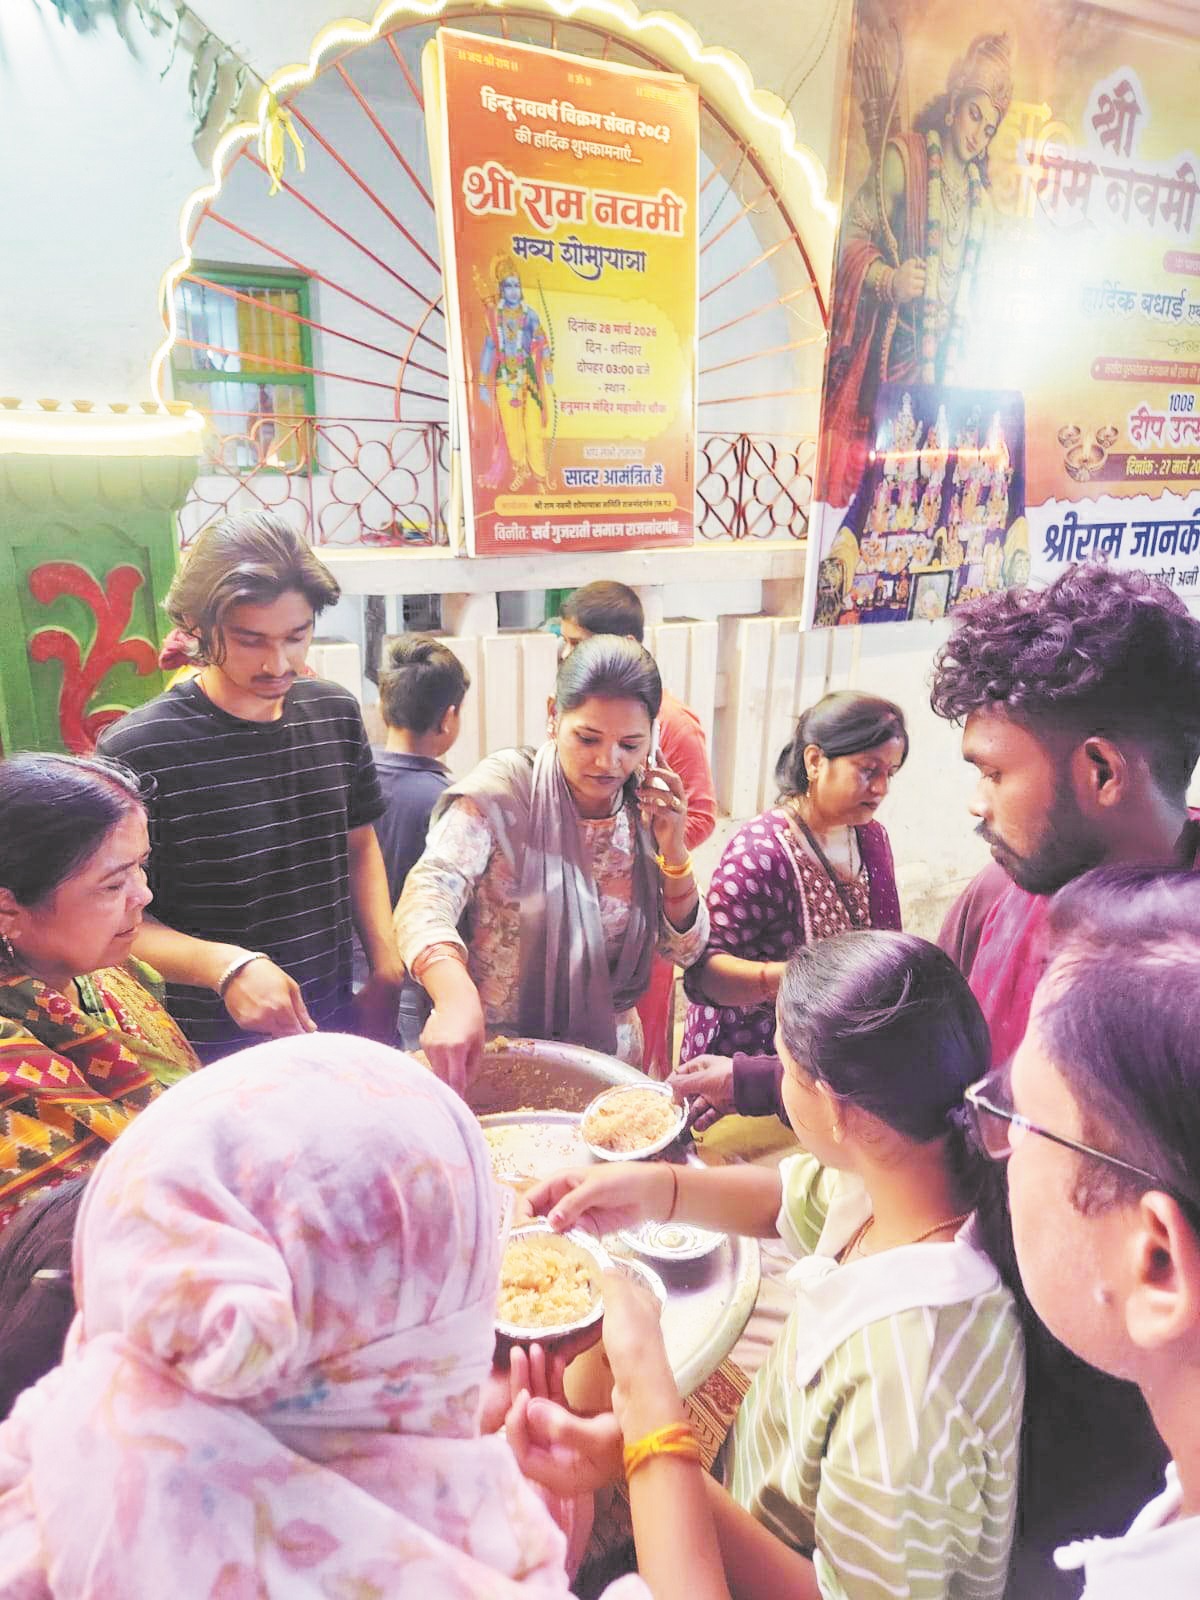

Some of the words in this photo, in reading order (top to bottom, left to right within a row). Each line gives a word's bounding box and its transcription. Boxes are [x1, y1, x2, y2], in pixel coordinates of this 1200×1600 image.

[480, 86, 517, 121] हिन्दू
[515, 99, 559, 122] नववर्ष
[560, 101, 601, 129] विक्रम
[603, 112, 636, 135] संवत
[637, 121, 671, 144] २०८३
[1092, 80, 1142, 157] श्री
[515, 125, 531, 145] की
[533, 130, 570, 152] हार्दिक
[465, 164, 516, 212] श्री
[522, 182, 586, 229] राम
[594, 192, 684, 233] नवमी
[1100, 162, 1200, 233] नवमी
[512, 236, 555, 262] भव्य
[559, 235, 647, 280] शोभायात्रा
[1141, 288, 1187, 320] बधाई
[567, 317, 597, 333] दिनांक
[599, 323, 611, 334] 28
[613, 322, 632, 335] मार्च
[634, 326, 657, 337] 2026
[585, 339, 601, 353] दिन
[610, 341, 642, 355] शनिवार
[576, 359, 604, 374] दोपहर
[606, 364, 634, 375] 03:00
[636, 363, 650, 375] बजे
[604, 383, 626, 393] स्थान
[560, 401, 590, 415] हनुमान
[592, 399, 614, 413] मंदिर
[1169, 394, 1195, 412] 1008
[1130, 405, 1166, 443] दीप
[564, 469, 599, 485] सादर
[604, 464, 651, 485] आमंत्रित
[654, 465, 663, 484] है
[1126, 455, 1153, 476] दिनांक
[1160, 459, 1171, 475] 27
[1171, 455, 1190, 475] मार्च
[530, 521, 550, 540] सर्व
[551, 520, 590, 544] गुजराती
[591, 523, 624, 538] समाज
[1043, 511, 1127, 562] श्रीराम
